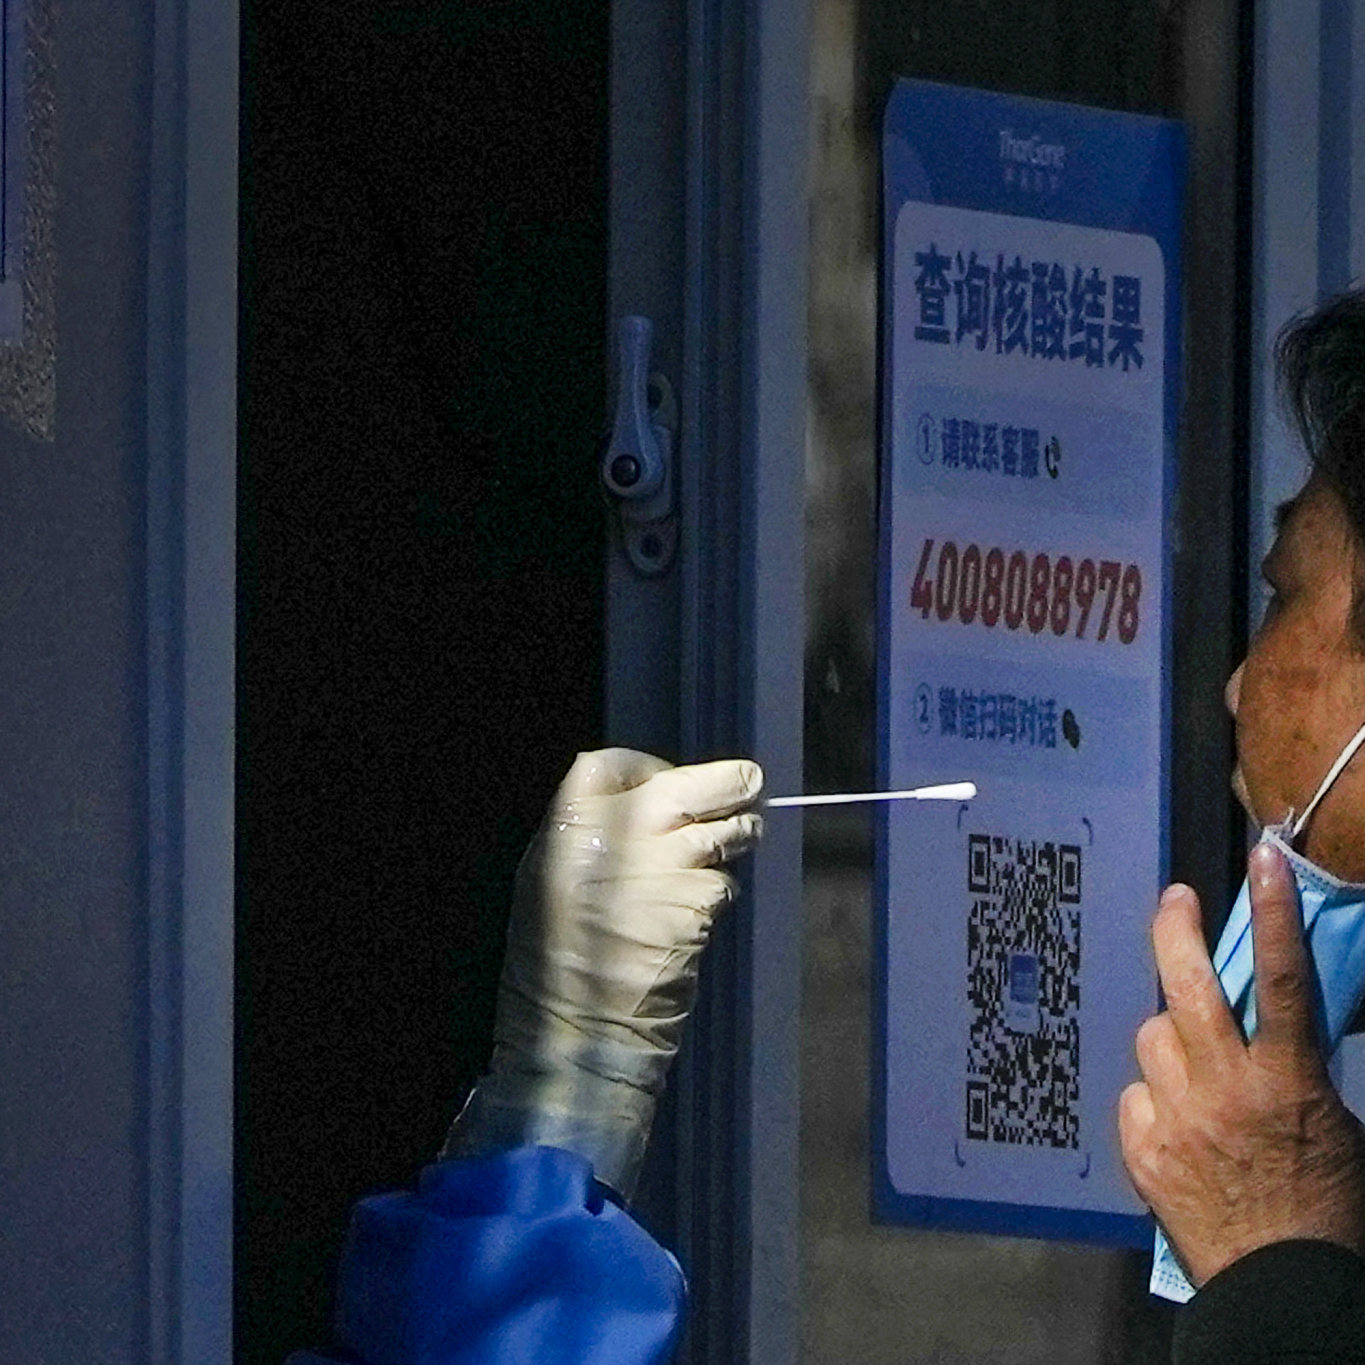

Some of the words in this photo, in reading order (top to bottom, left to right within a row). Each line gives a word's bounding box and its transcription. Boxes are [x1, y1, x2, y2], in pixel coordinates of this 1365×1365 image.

[914, 243, 1144, 372] 查询核酸结果
[910, 538, 1142, 645] 4008088978
